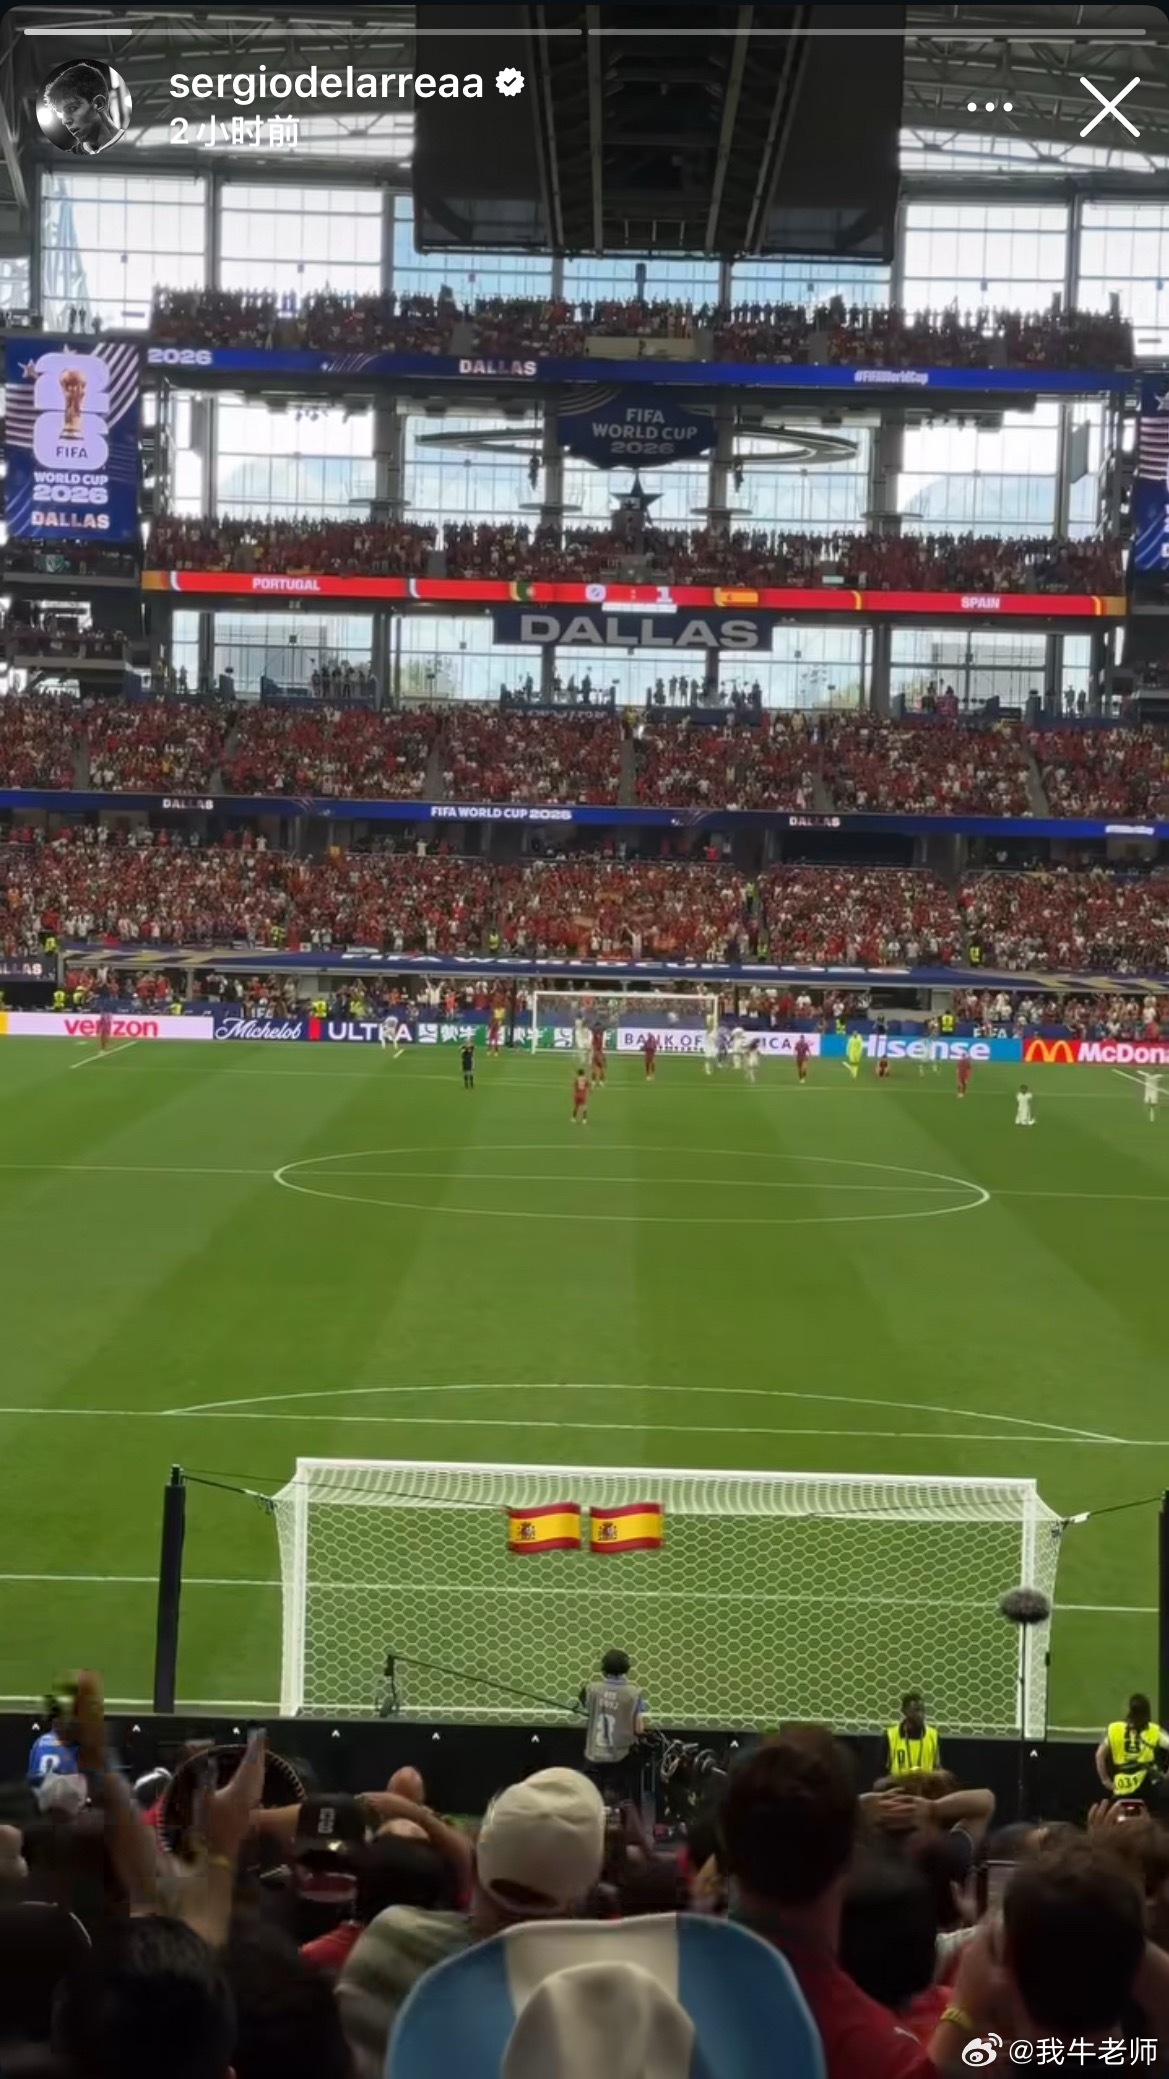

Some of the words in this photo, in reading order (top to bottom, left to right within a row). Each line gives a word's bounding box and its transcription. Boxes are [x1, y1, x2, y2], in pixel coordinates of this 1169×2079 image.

[147, 347, 213, 366] 2026
[459, 359, 537, 376] DALLAS
[626, 408, 665, 424] FIFA
[592, 422, 658, 440] WORLD
[661, 426, 698, 440] CUP
[56, 446, 88, 459] FIFA
[611, 442, 675, 455] 2026
[34, 471, 80, 484] WORLD
[82, 474, 109, 486] CUP
[33, 484, 109, 505] 2026
[31, 511, 110, 530] DALLAS
[253, 577, 321, 592] PORTUGAL
[656, 586, 673, 604] 1
[961, 596, 1000, 609] SPAIN
[520, 614, 759, 648] DALLAS
[430, 806, 458, 818] FIFA
[458, 807, 502, 819] WORLD
[503, 809, 529, 820] CUP
[529, 809, 573, 821] 2026
[215, 1017, 303, 1040] Michelob
[861, 1033, 990, 1061] Hisense
